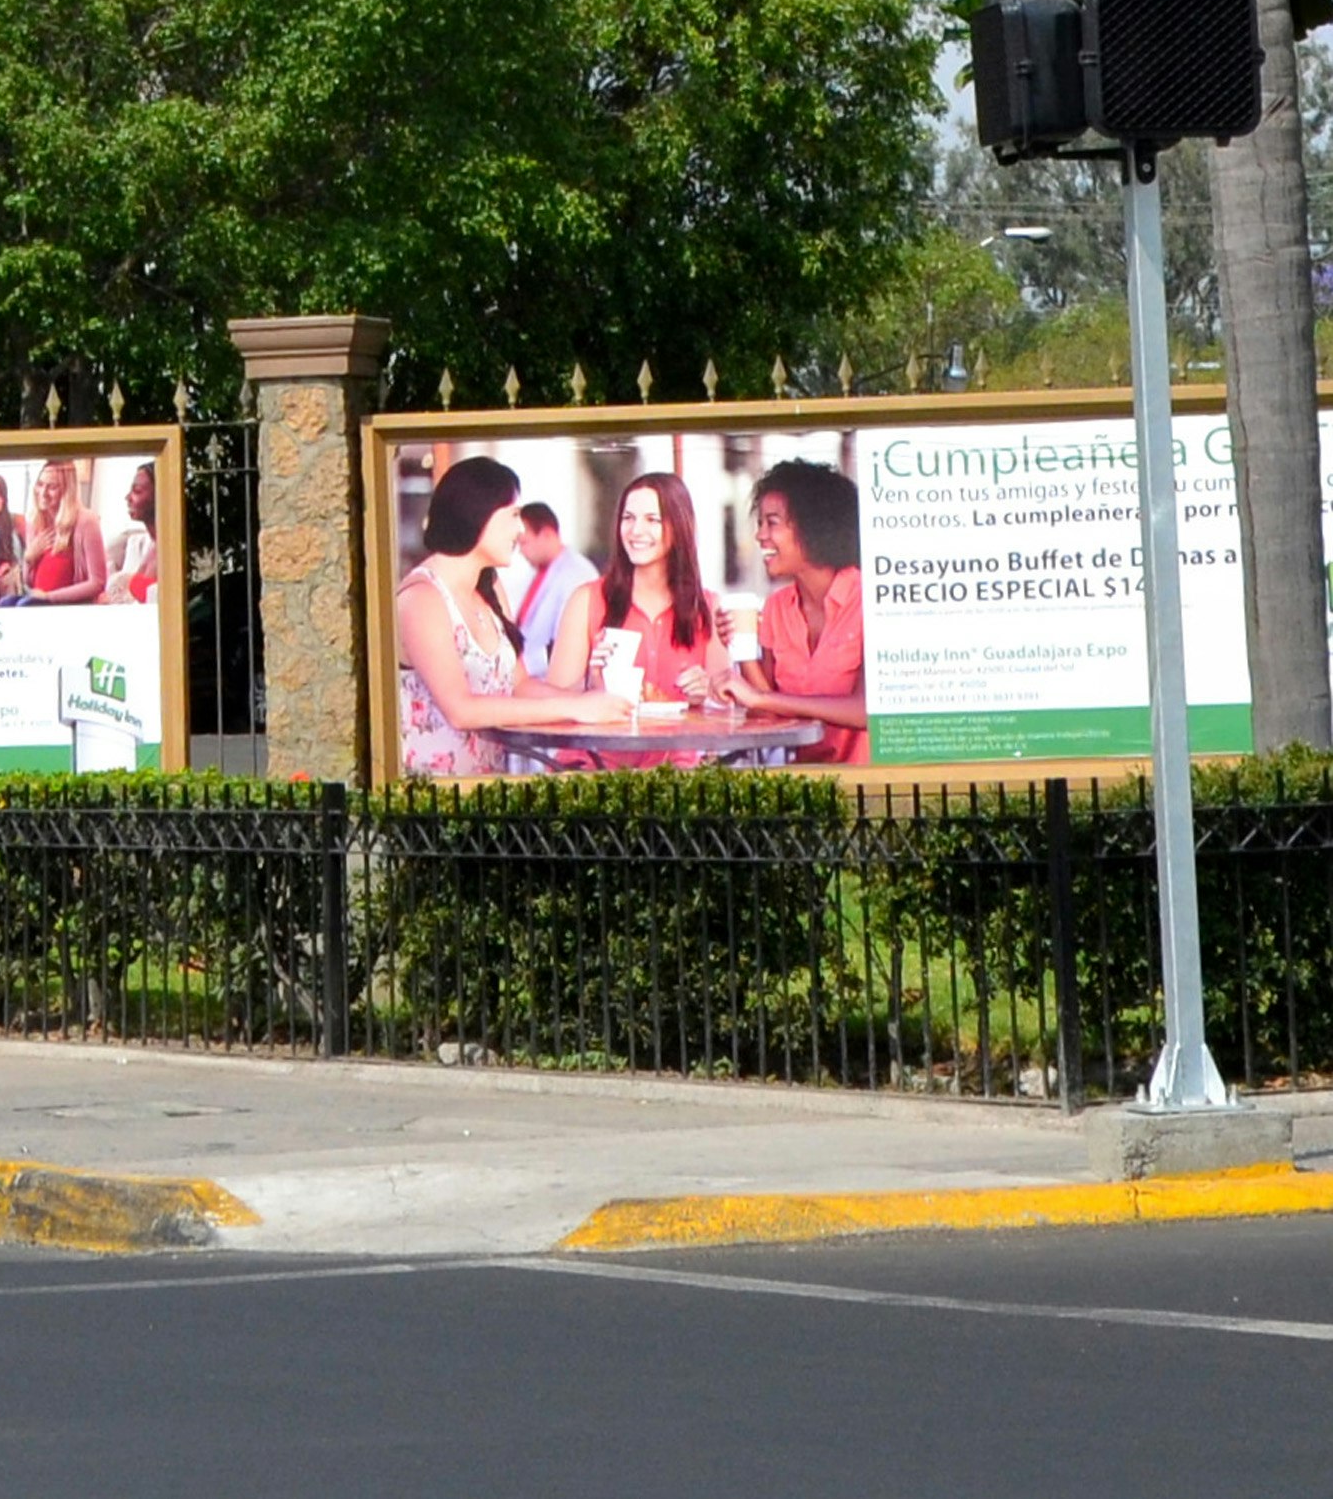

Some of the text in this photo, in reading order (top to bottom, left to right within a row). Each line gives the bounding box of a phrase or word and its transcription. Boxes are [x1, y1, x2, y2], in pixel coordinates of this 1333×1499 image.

[872, 434, 1187, 488] ¡Cumpleañea
[871, 486, 910, 503] Ven
[916, 488, 953, 503] con
[960, 486, 990, 501] tus
[996, 481, 1069, 504] amigas
[1075, 483, 1085, 501] y
[872, 511, 967, 529] nosotros.
[973, 509, 997, 527] La
[1185, 503, 1221, 522] por
[875, 555, 1000, 580] Desayuno
[1008, 548, 1083, 572] Buffet
[1092, 547, 1122, 568] de
[1224, 549, 1237, 565] a
[876, 581, 968, 604] PRECIO
[976, 578, 1095, 602] ESPECIAL
[877, 648, 940, 665] Holiday
[983, 644, 1082, 661] Guadalajara
[1087, 643, 1127, 659] Expo
[67, 694, 143, 728] Holiday Inn
